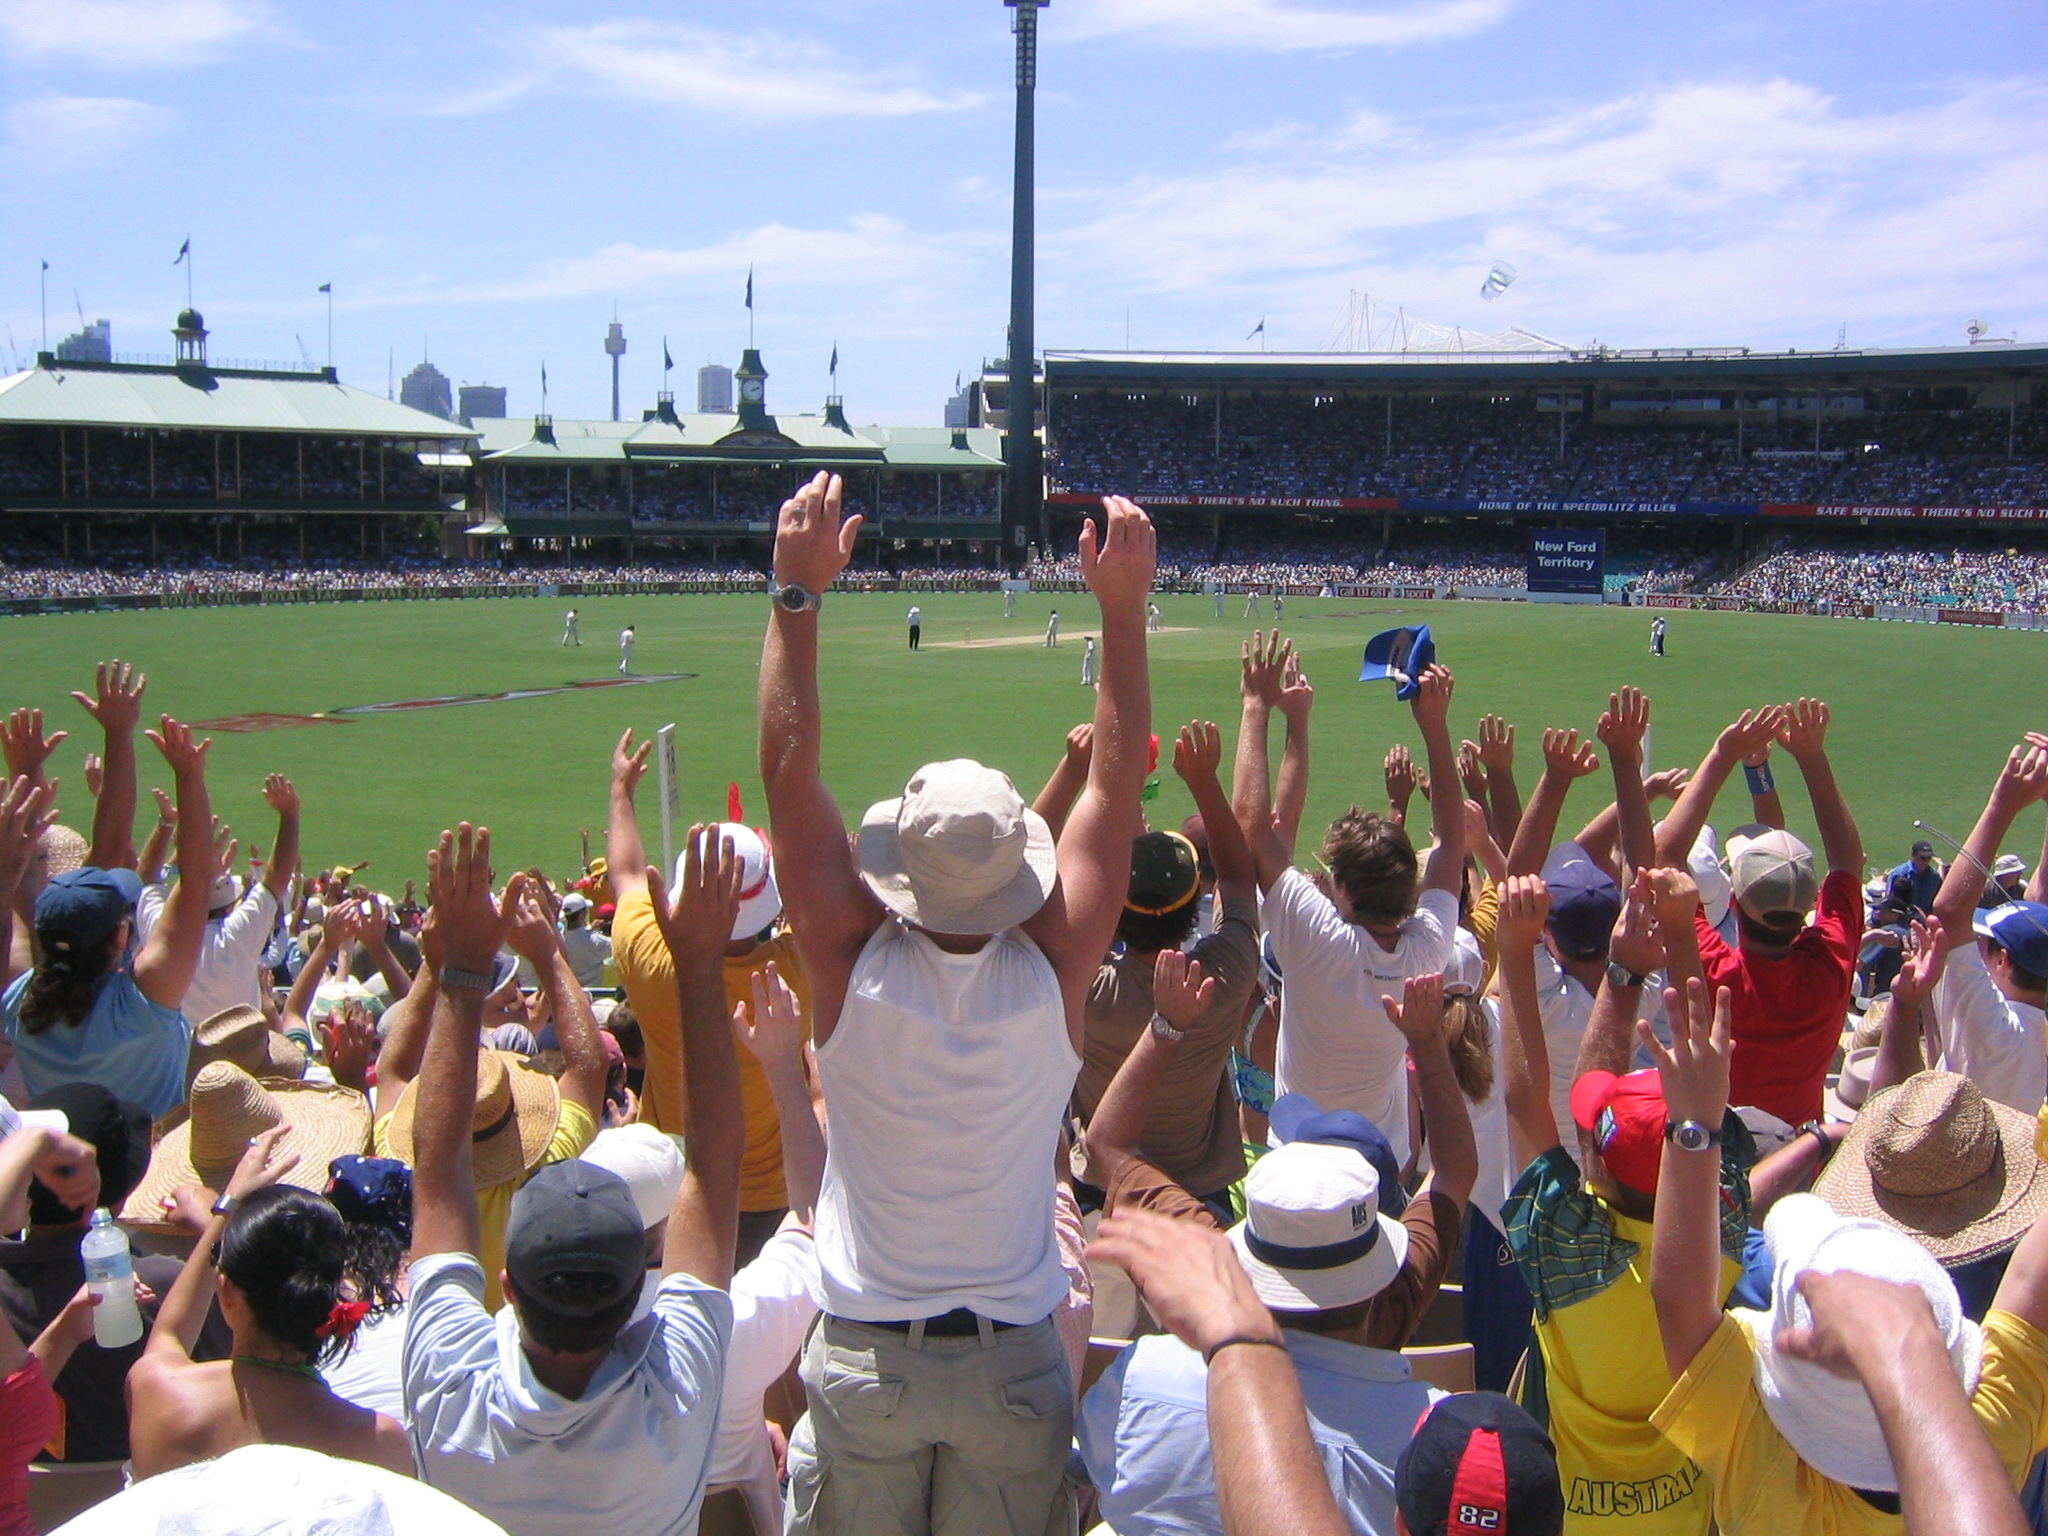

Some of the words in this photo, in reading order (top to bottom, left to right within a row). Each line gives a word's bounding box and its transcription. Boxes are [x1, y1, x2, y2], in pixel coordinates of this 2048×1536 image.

[1198, 496, 1245, 505] THERE'S
[1248, 498, 1266, 506] NO
[1270, 498, 1301, 507] SUCH
[1305, 498, 1344, 507] THING.
[1478, 502, 1512, 510] HOME
[1516, 502, 1532, 511] OF
[1536, 502, 1558, 511] THE
[1562, 502, 1634, 512] SPEEDBLITZ
[1638, 503, 1677, 512] BLUES
[1816, 506, 1848, 516] SAFE
[1851, 507, 1917, 517] SPEEDING.
[1921, 507, 1973, 518] THERE'S
[1976, 508, 1995, 518] NO
[1999, 508, 2034, 518] SUCH
[1015, 524, 1027, 546] 6
[1534, 541, 1564, 552] New
[1567, 541, 1597, 553] Ford
[1537, 556, 1595, 571] Territory
[1405, 589, 1430, 599] sport
[1648, 595, 1675, 607] video
[1459, 1504, 1500, 1528] 82
